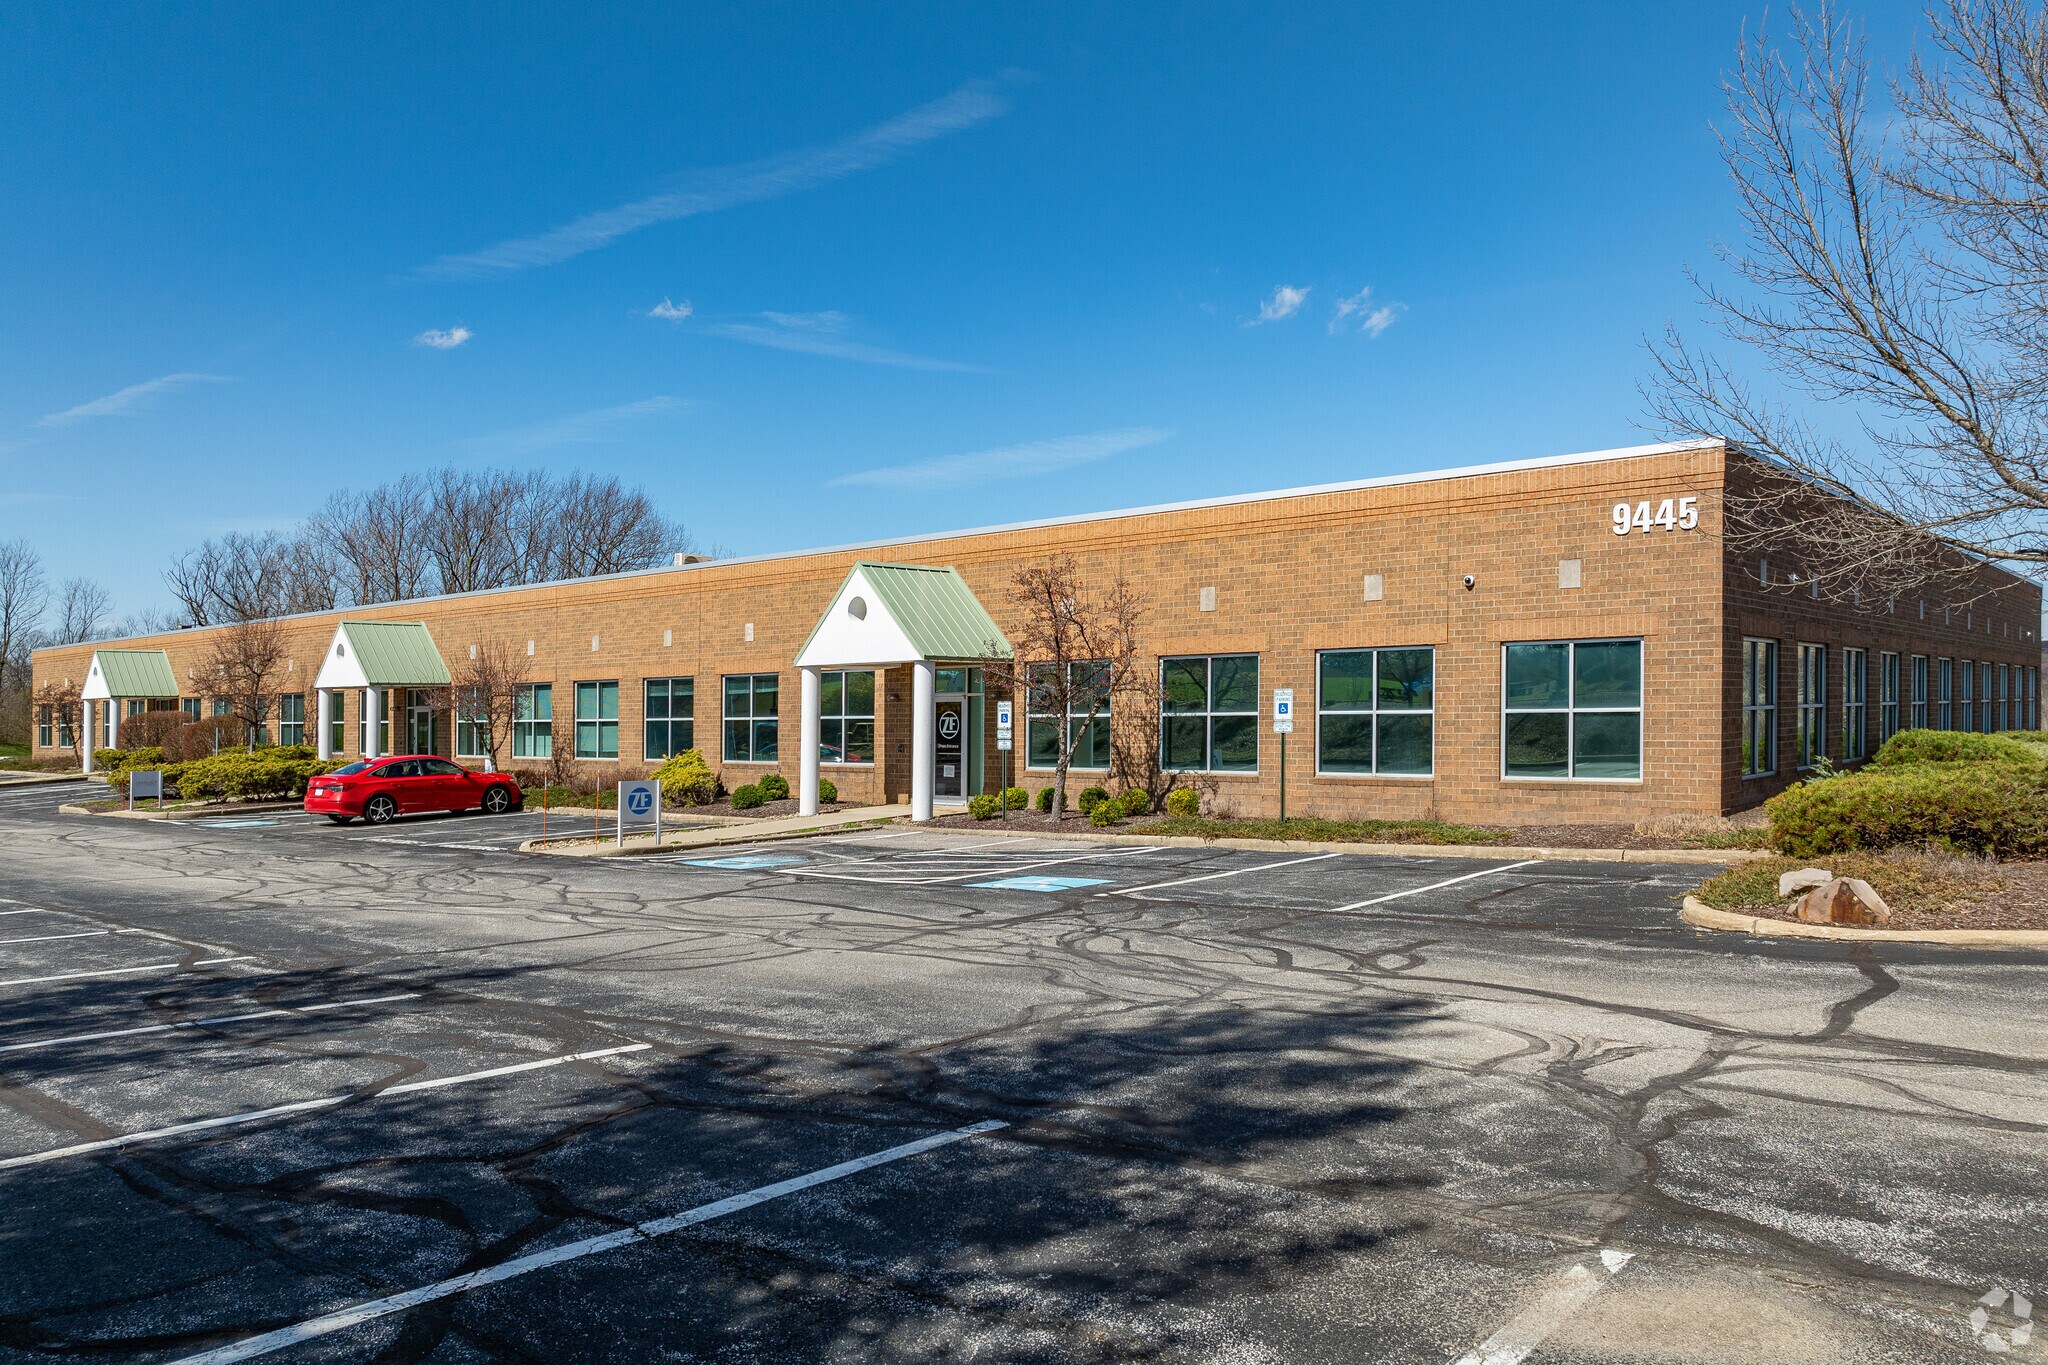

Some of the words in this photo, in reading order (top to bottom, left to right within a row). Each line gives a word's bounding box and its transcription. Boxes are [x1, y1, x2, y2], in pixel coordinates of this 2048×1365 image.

[1612, 497, 1698, 535] 9445
[941, 716, 958, 734] ZF
[630, 791, 652, 811] ZF
